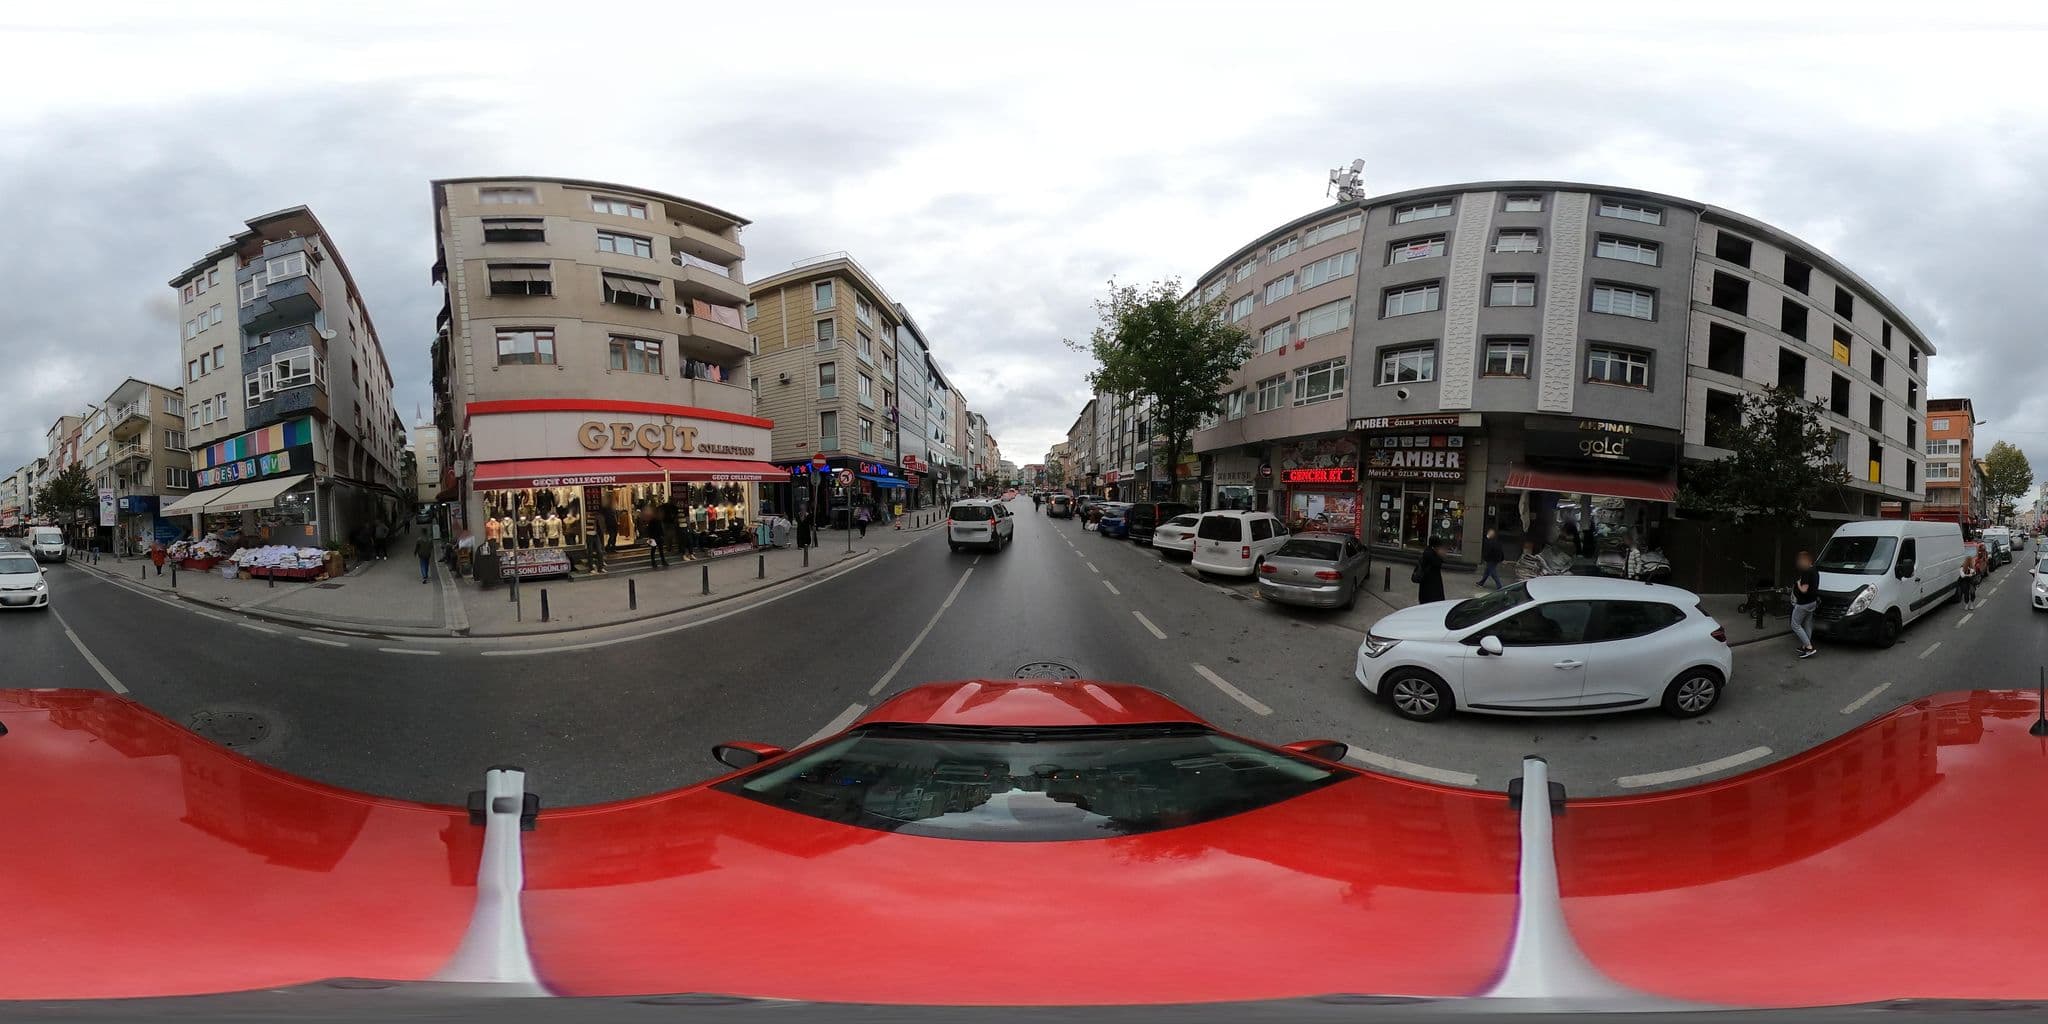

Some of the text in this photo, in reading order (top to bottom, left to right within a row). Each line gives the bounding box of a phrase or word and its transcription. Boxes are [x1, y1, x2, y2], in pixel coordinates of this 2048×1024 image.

[1354, 417, 1454, 430] AMBER ÖZLEM TOBACCO
[1579, 420, 1633, 434] AKPINAR
[577, 414, 755, 457] GEÇİT COLLECTION
[1391, 450, 1460, 468] AMBER
[197, 459, 257, 487] KADEŞLER
[1398, 469, 1419, 477] ÖZLEM
[1422, 470, 1461, 479] TOBACCO
[562, 476, 616, 485] COLLECTION
[518, 565, 537, 575] SONU
